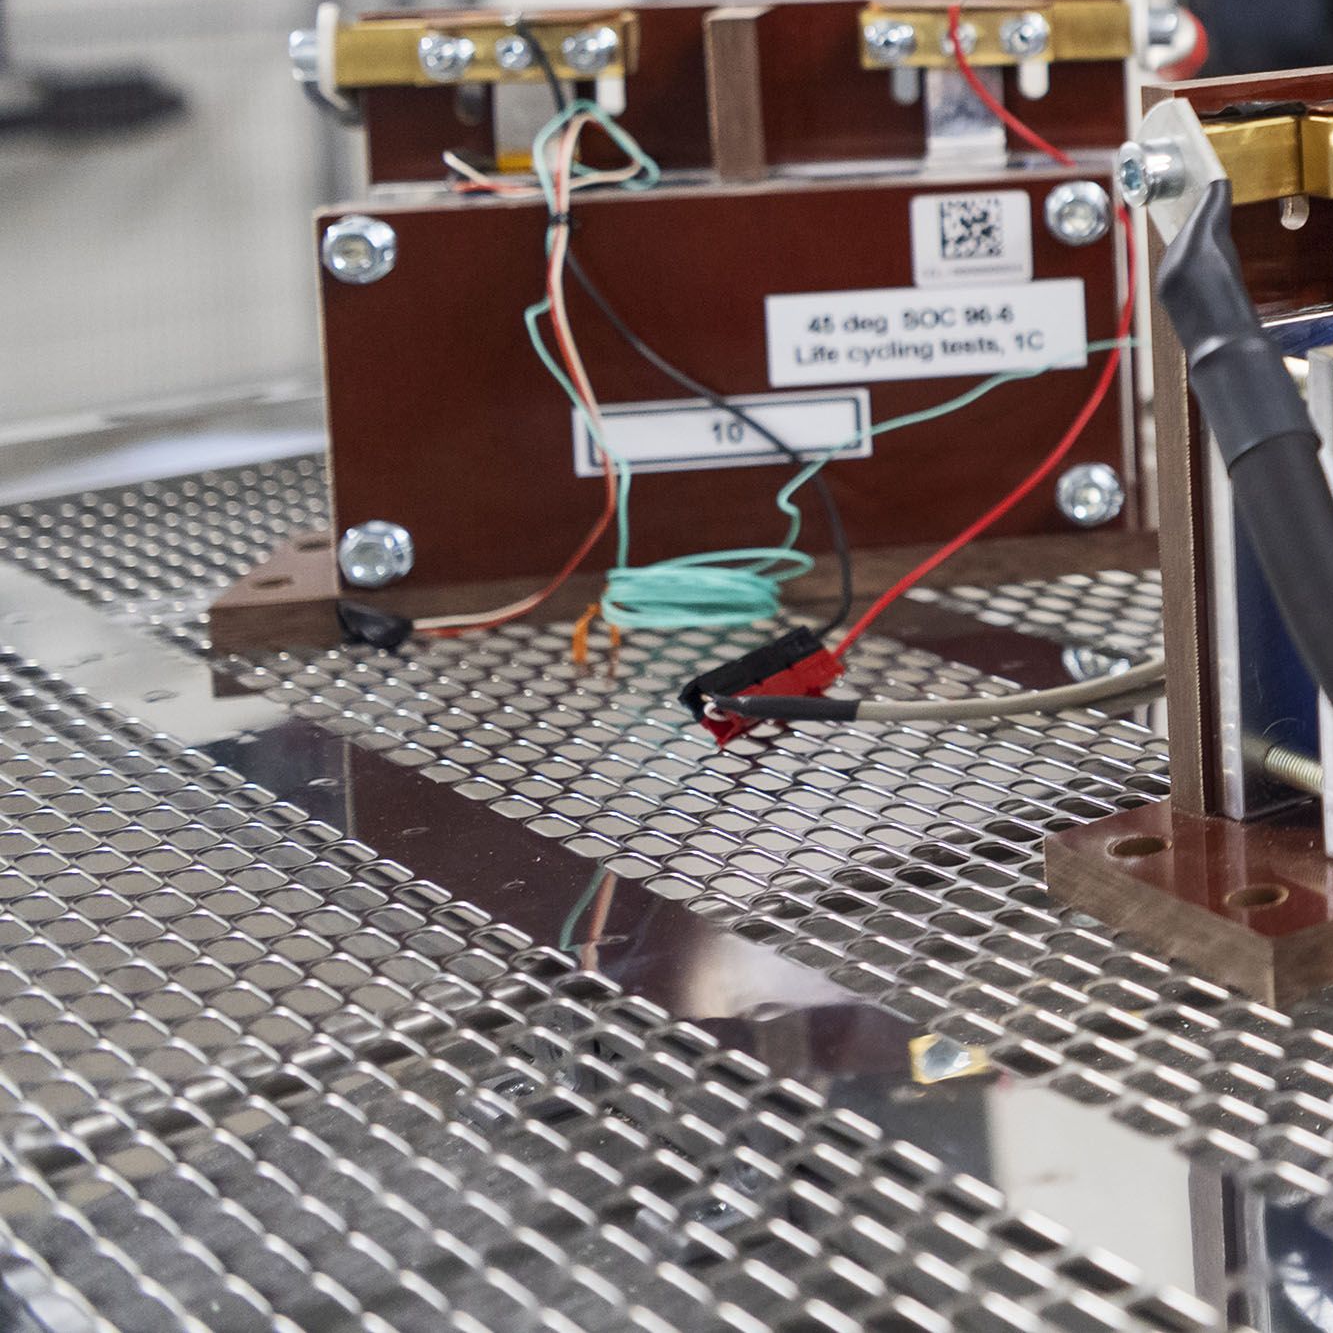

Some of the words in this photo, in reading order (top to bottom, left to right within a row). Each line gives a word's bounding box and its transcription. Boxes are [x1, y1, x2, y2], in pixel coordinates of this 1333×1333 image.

[809, 314, 834, 334] 45
[844, 314, 888, 336] deg
[903, 308, 956, 329] SOC
[965, 306, 1014, 326] 96-6
[796, 345, 839, 365] Life
[848, 340, 933, 366] cycling
[941, 337, 1004, 356] tests,
[1015, 331, 1044, 350] 1C
[713, 423, 744, 443] 10
